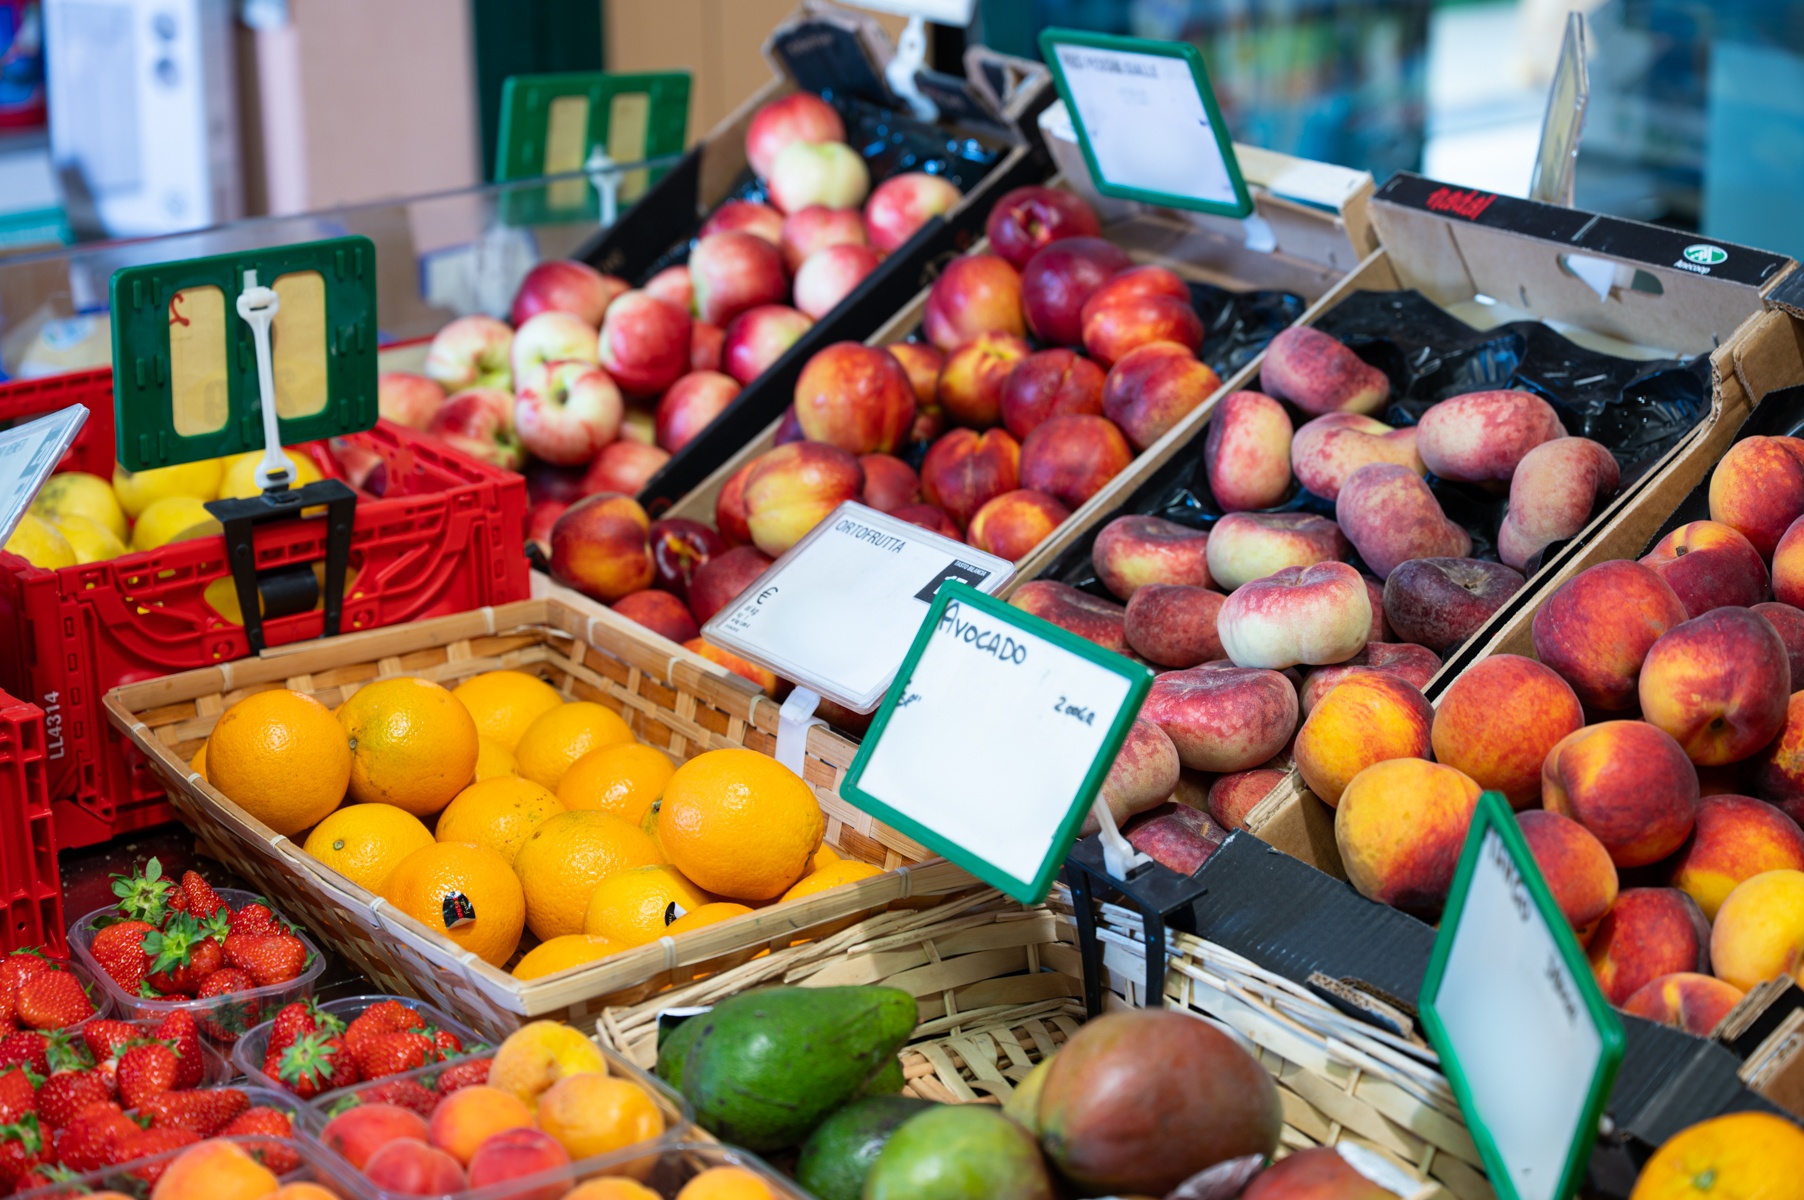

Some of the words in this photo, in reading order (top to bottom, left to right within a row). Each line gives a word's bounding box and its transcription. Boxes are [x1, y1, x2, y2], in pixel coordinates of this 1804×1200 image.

[835, 519, 906, 553] ORTOFRUTTA
[954, 560, 970, 570] TASTO
[967, 565, 987, 577] BILANCIA
[756, 586, 779, 605] €
[938, 602, 1027, 664] AVOCADO
[44, 690, 65, 760] LL4314
